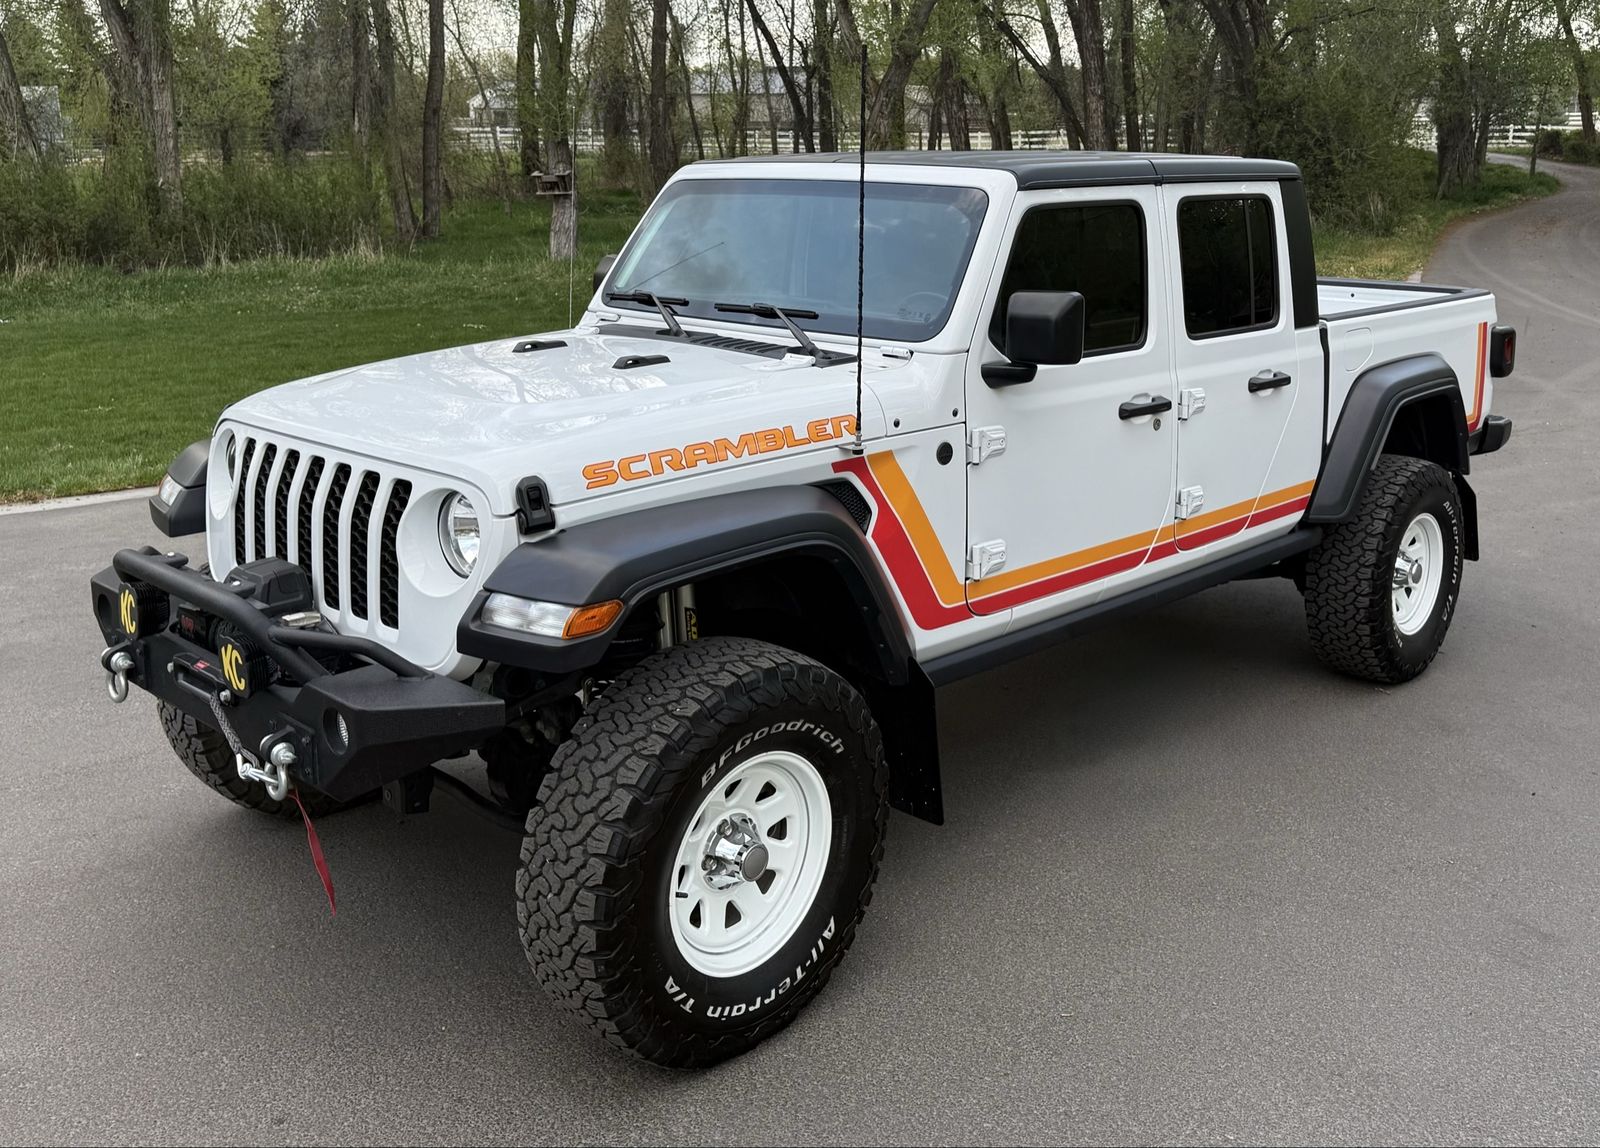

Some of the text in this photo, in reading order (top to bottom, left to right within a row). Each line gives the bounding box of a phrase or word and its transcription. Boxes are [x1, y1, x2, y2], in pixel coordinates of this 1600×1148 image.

[582, 414, 858, 490] SCRAMBLER
[1442, 500, 1459, 584] All-Terrain
[120, 589, 136, 634] KC
[220, 643, 246, 692] KC
[701, 718, 845, 789] BFGoodrich
[664, 915, 836, 1021] All-Terrain T/A
